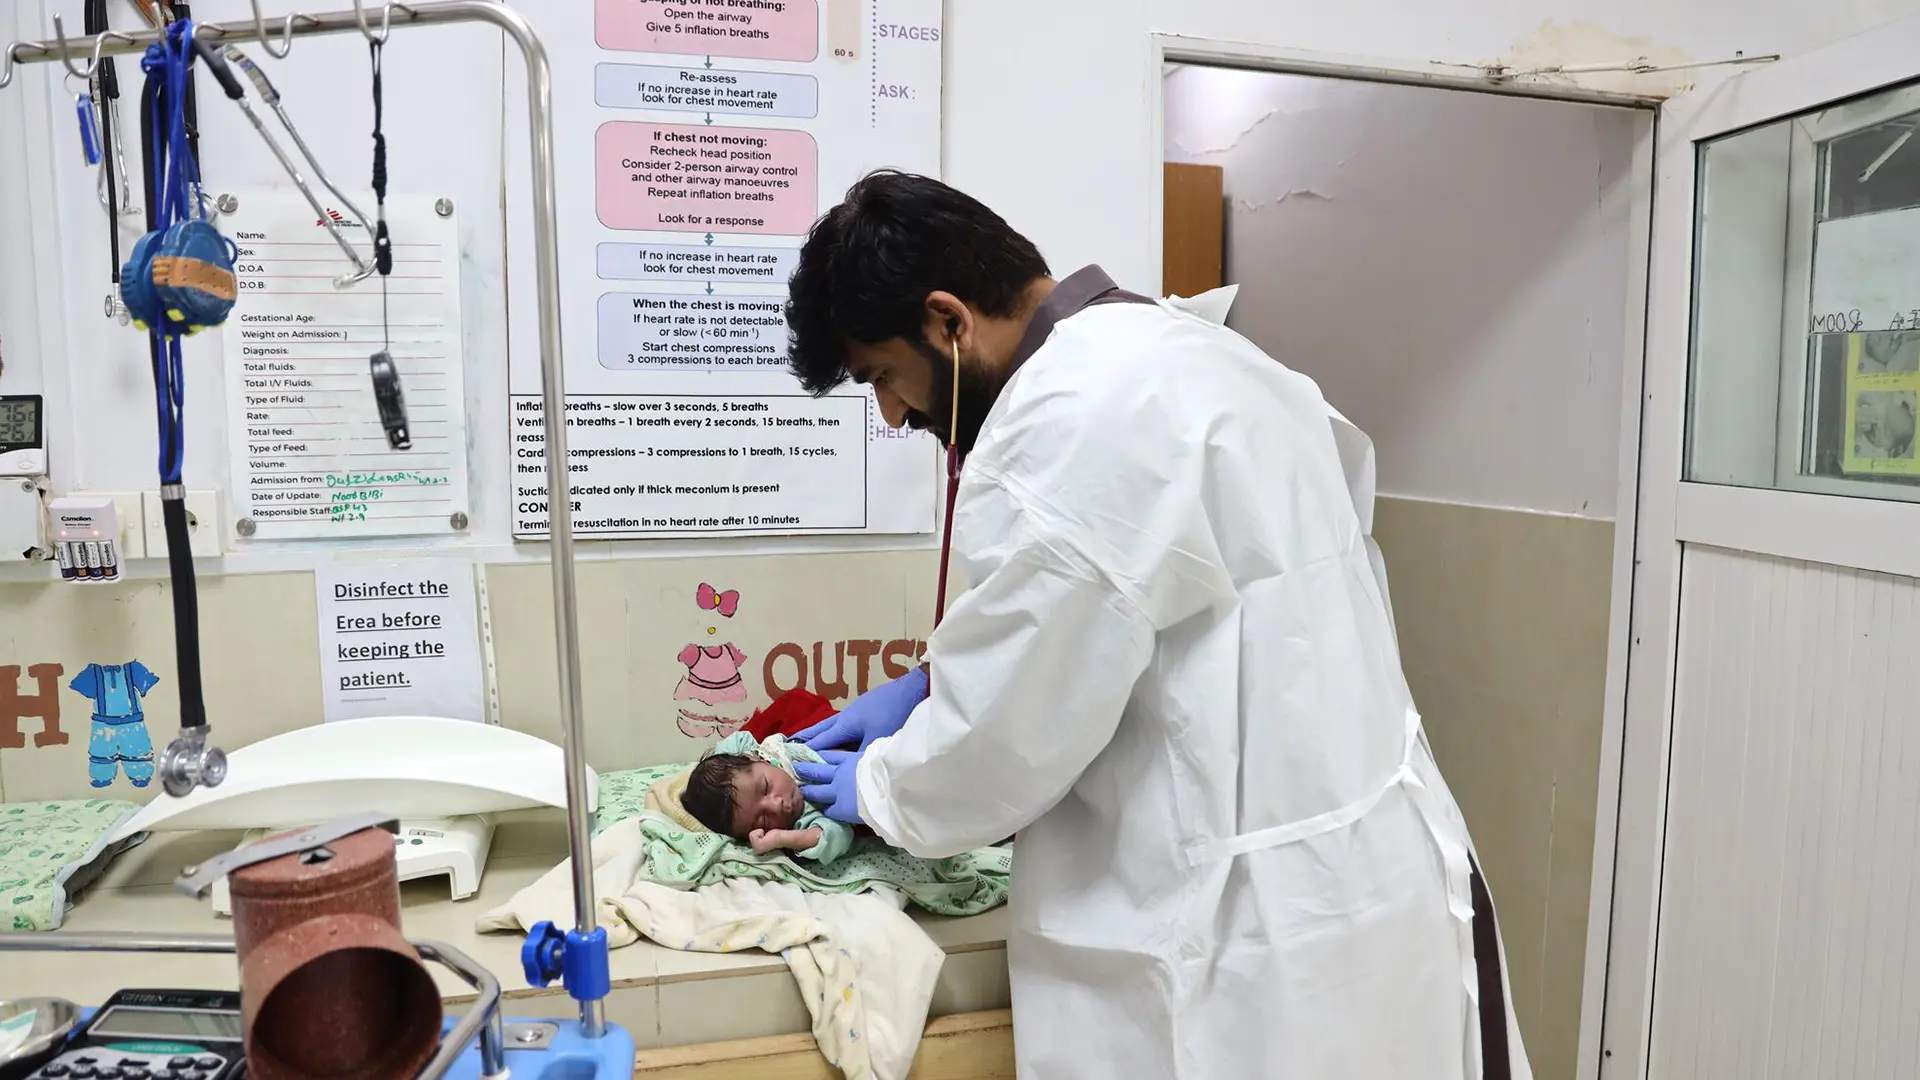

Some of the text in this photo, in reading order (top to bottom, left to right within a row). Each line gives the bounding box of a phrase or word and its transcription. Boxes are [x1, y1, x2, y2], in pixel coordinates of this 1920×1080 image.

[664, 8, 752, 25] Open the airway
[646, 22, 769, 39] Give 5 inflation breaths
[878, 24, 940, 42] STAGES
[680, 71, 737, 84] Re-assess
[654, 131, 767, 148] If chest not moving:
[650, 145, 771, 160] Recheck head position
[622, 158, 798, 176] Consider 2-person airway control
[632, 172, 789, 188] and other airway manoeuvres
[648, 187, 774, 201] Repeat inflation breaths
[658, 213, 685, 223] Look
[688, 214, 702, 224] for
[715, 217, 764, 227] response
[640, 250, 778, 264] If no increase in heart rate
[644, 263, 773, 276] look for chest movement
[633, 299, 784, 313] When the chest is moving:
[241, 314, 315, 323] Gestational Age:
[634, 314, 784, 326] If heart rate is not detectable
[242, 330, 276, 340] Weight
[292, 331, 342, 340] Admission:
[243, 347, 289, 356] Diagnosis:
[642, 342, 775, 356] Start chest compressions
[628, 354, 790, 366] 3 compressions to each breath
[244, 363, 266, 371] Total
[244, 379, 314, 388] Total I/V Fluids:
[245, 396, 268, 405] Type
[281, 395, 306, 404] Fluid:
[613, 402, 636, 411] slow
[665, 402, 671, 411] 3
[674, 402, 719, 412] seconds,
[722, 402, 728, 412] 5
[731, 402, 768, 411] breaths
[247, 412, 269, 420] Rate:
[517, 417, 840, 428] Ventin breaths 1 breath every 2 seconds, 15 breaths, then
[247, 428, 294, 436] Total feed:
[248, 444, 308, 454] Type of Feed:
[648, 447, 654, 456] 3
[656, 448, 726, 458] compressions
[728, 448, 739, 456] to
[742, 447, 746, 456] 1
[750, 447, 785, 456] breath,
[789, 446, 800, 456] 15
[802, 447, 837, 457] cycles,
[251, 476, 298, 485] Admission
[300, 476, 324, 484] from:
[275, 492, 284, 500] of
[286, 492, 321, 500] Update:
[518, 484, 780, 496] Suctio dicated only if thick meconium is present
[252, 507, 332, 517] Responsible Staff:
[574, 518, 639, 528] resuscitation
[642, 518, 651, 526] in
[670, 517, 696, 526] heart
[699, 517, 719, 526] rate
[722, 516, 744, 526] after
[748, 516, 759, 524] 10
[762, 515, 800, 524] minutes
[334, 580, 448, 598] Disinfect the
[336, 612, 441, 629] Erea before
[338, 640, 444, 659] keeping the
[340, 672, 410, 690] patient.
